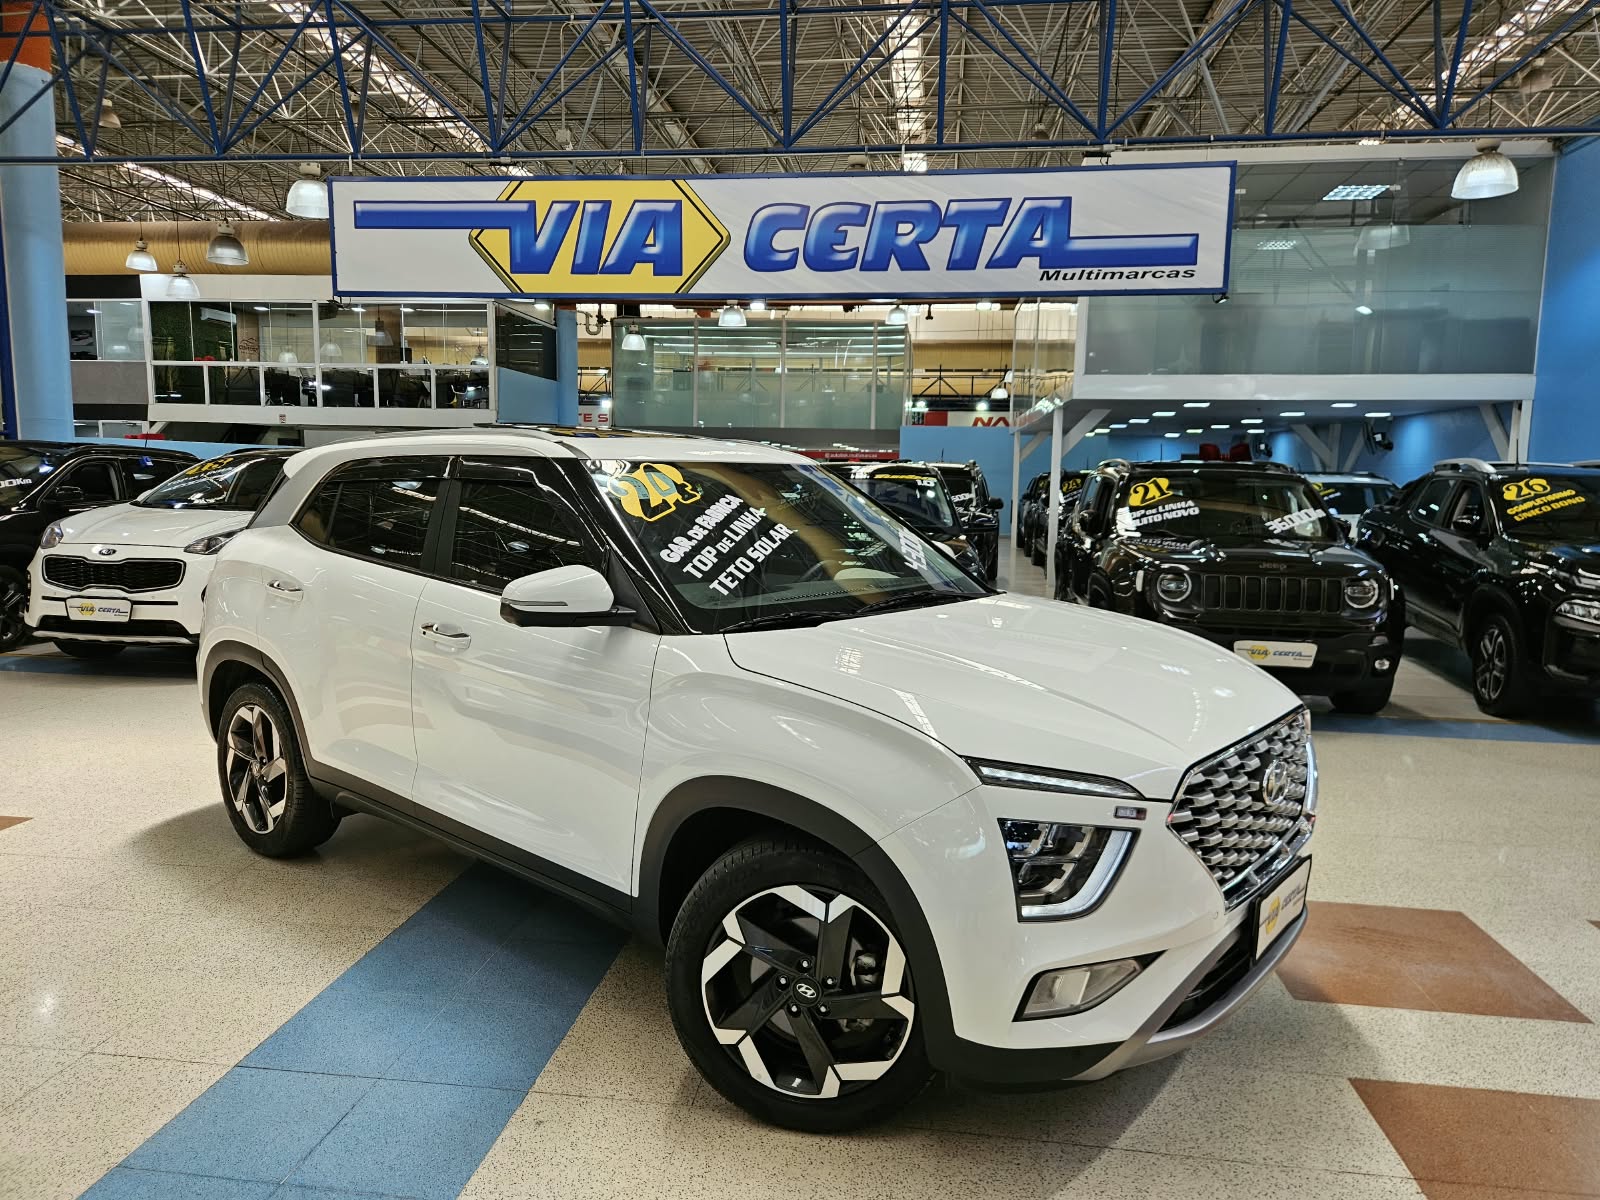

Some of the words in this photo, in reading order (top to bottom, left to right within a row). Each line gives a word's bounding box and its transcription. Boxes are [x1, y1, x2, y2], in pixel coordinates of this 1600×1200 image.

[509, 199, 683, 276] VIA
[743, 196, 1072, 272] CERTA
[1039, 269, 1196, 281] Multimarcas
[608, 463, 701, 522] 24
[1131, 478, 1173, 506] 21
[1503, 478, 1551, 501] 26
[1550, 496, 1586, 509] DONO
[695, 494, 744, 530] FABRICA
[1159, 500, 1195, 512] LINHA
[1163, 507, 1200, 520] NOVO
[687, 524, 709, 541] DE
[723, 507, 766, 542] LINHA
[659, 536, 698, 563] GAR.
[715, 537, 736, 554] DE
[682, 545, 718, 579] TOP
[709, 556, 755, 596] TETO
[746, 523, 795, 563] SOLAR
